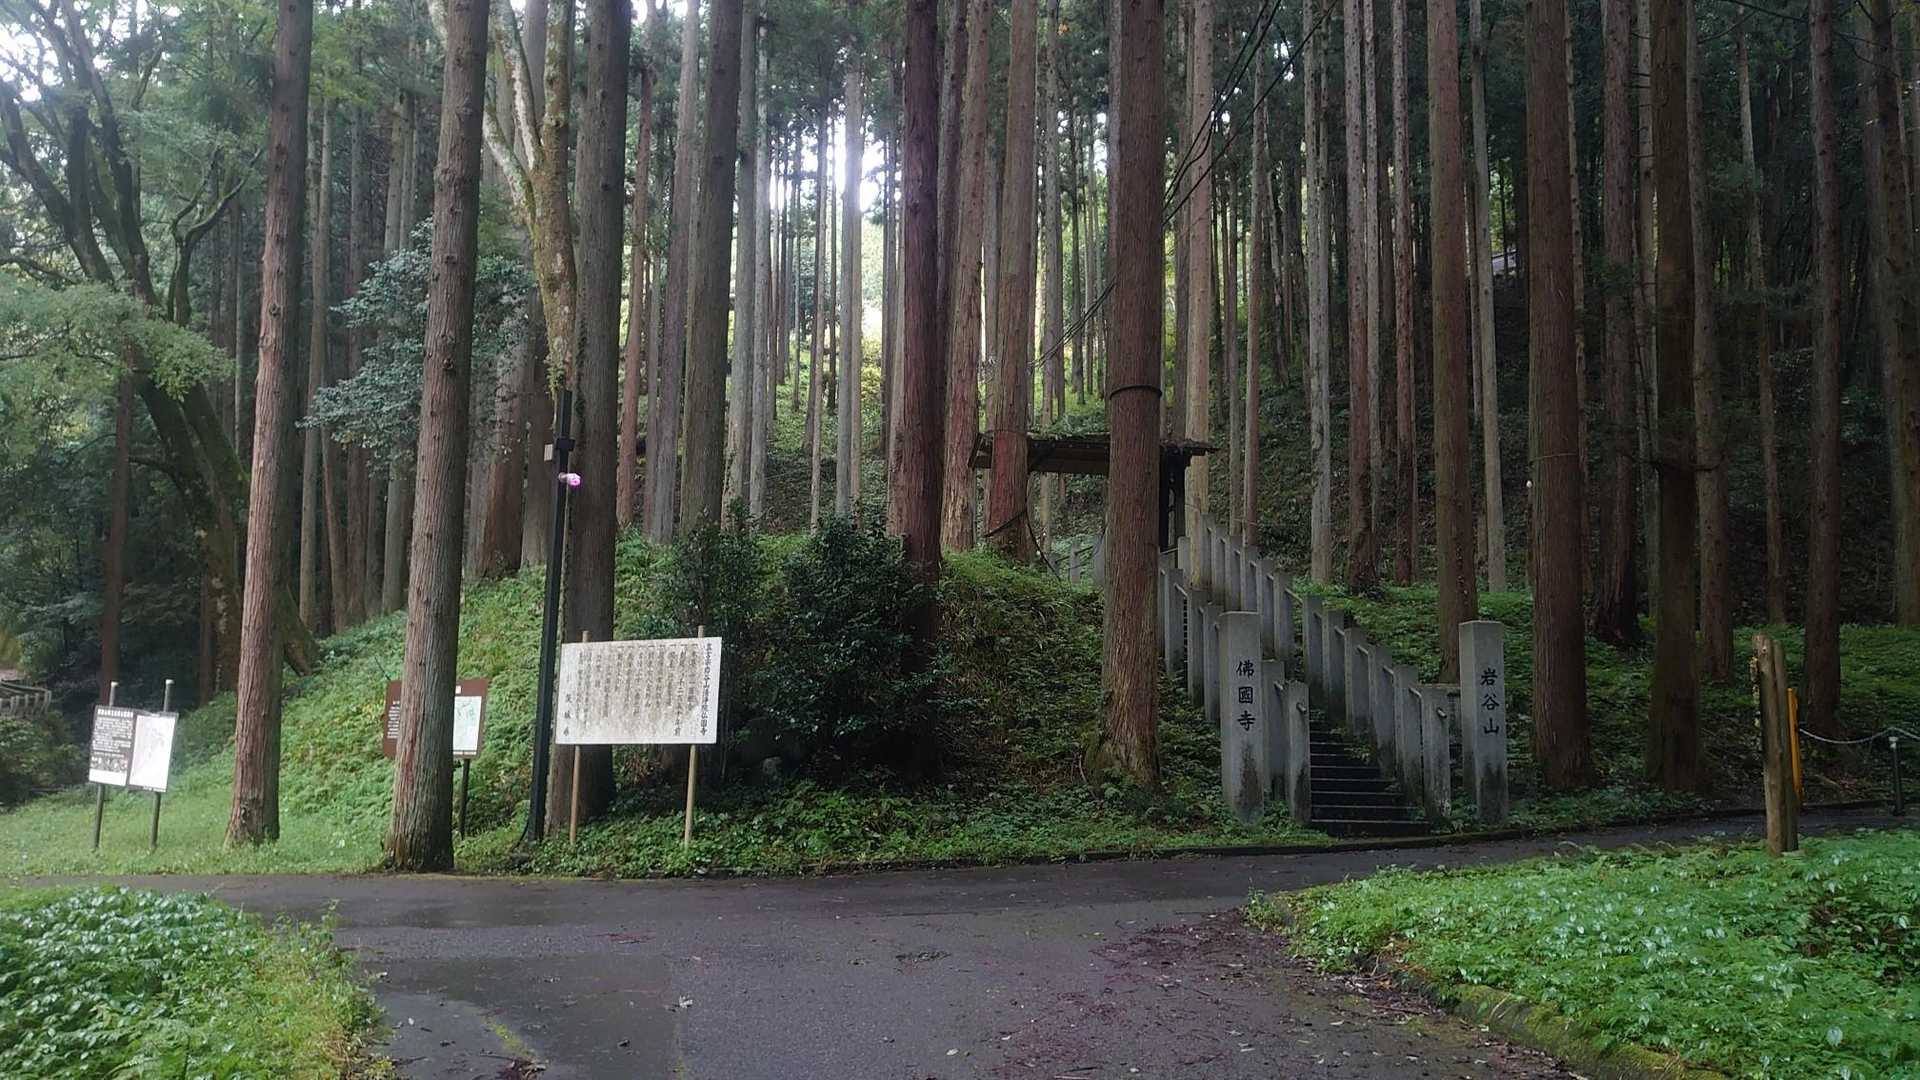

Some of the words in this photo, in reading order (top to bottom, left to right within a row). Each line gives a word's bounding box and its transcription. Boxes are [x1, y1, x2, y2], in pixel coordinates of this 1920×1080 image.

[1236, 660, 1256, 731] 佛國寺
[1480, 667, 1500, 735] 岩谷山
